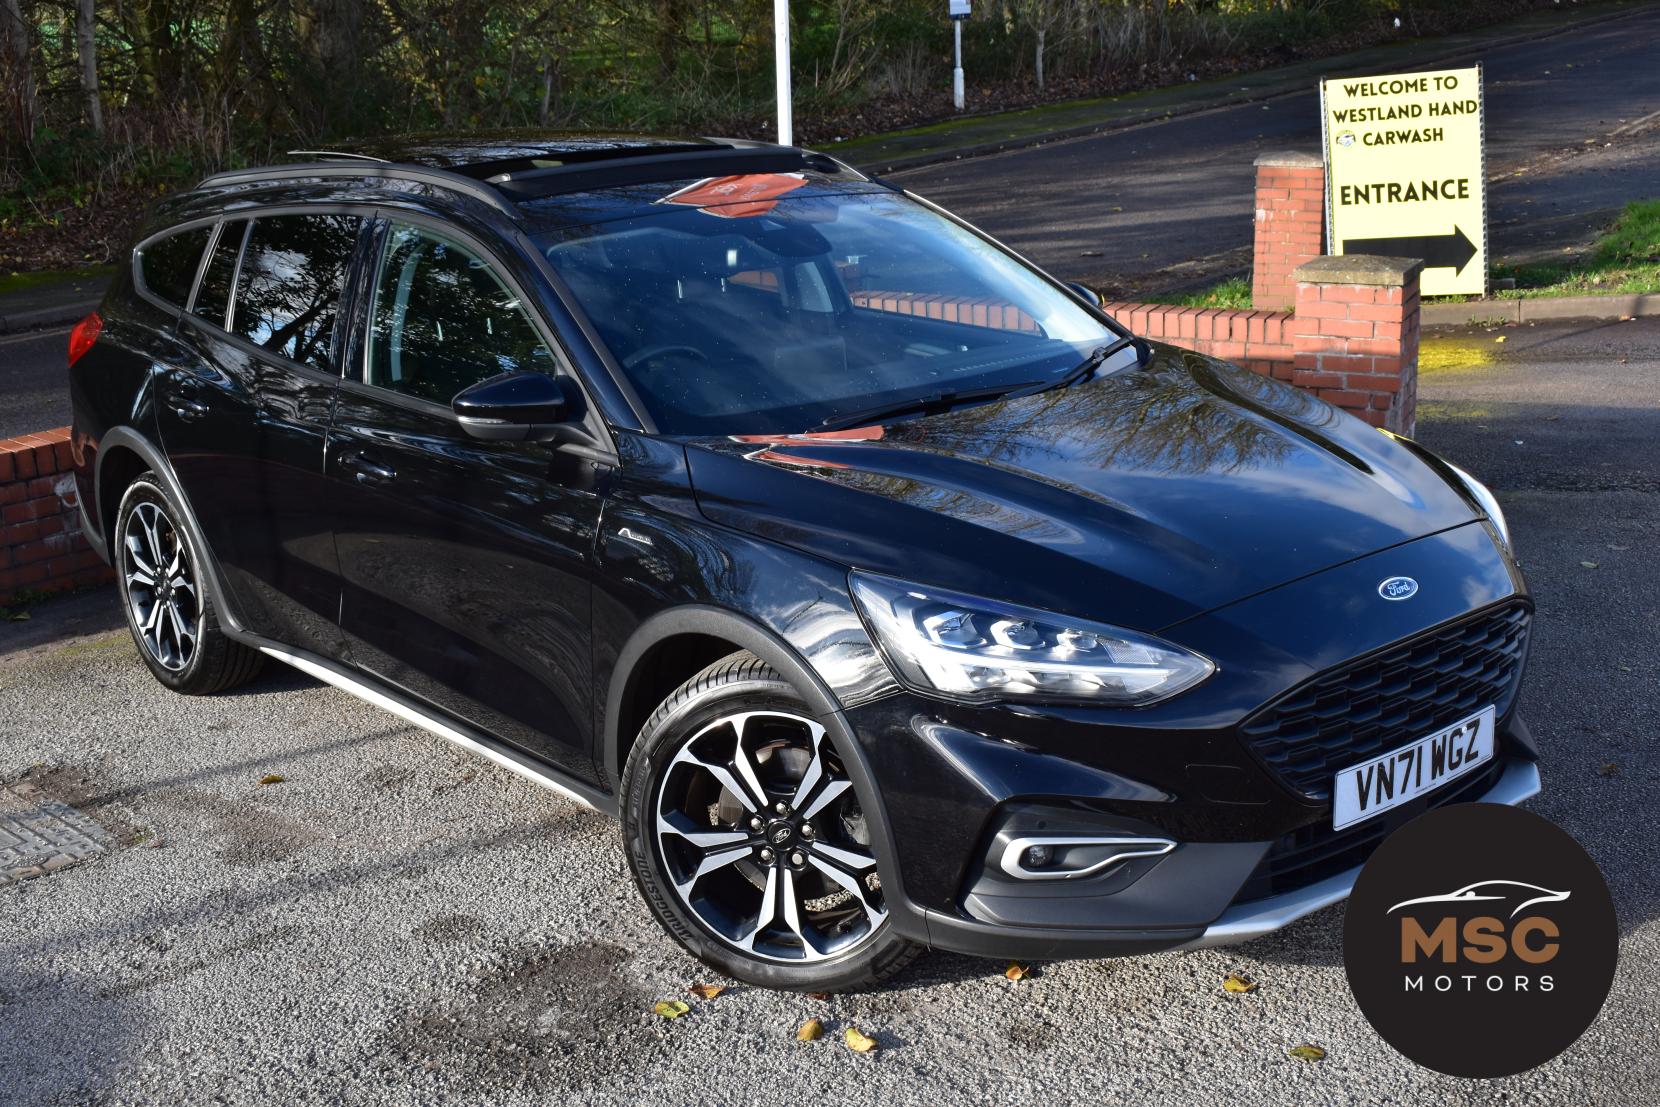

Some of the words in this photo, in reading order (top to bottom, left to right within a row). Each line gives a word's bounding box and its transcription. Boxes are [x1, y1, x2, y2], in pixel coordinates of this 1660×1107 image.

[1344, 78, 1428, 98] WELCOME
[1433, 75, 1458, 91] TO
[1333, 104, 1422, 123] WESTLAND
[1429, 100, 1477, 117] HAND
[1363, 128, 1443, 146] CARWASH
[1340, 178, 1469, 205] ENTRANCE
[1387, 581, 1411, 596] Ford
[1356, 746, 1423, 811] VN71
[1431, 718, 1480, 780] WGZ
[635, 851, 694, 941] BRIDGESTONE
